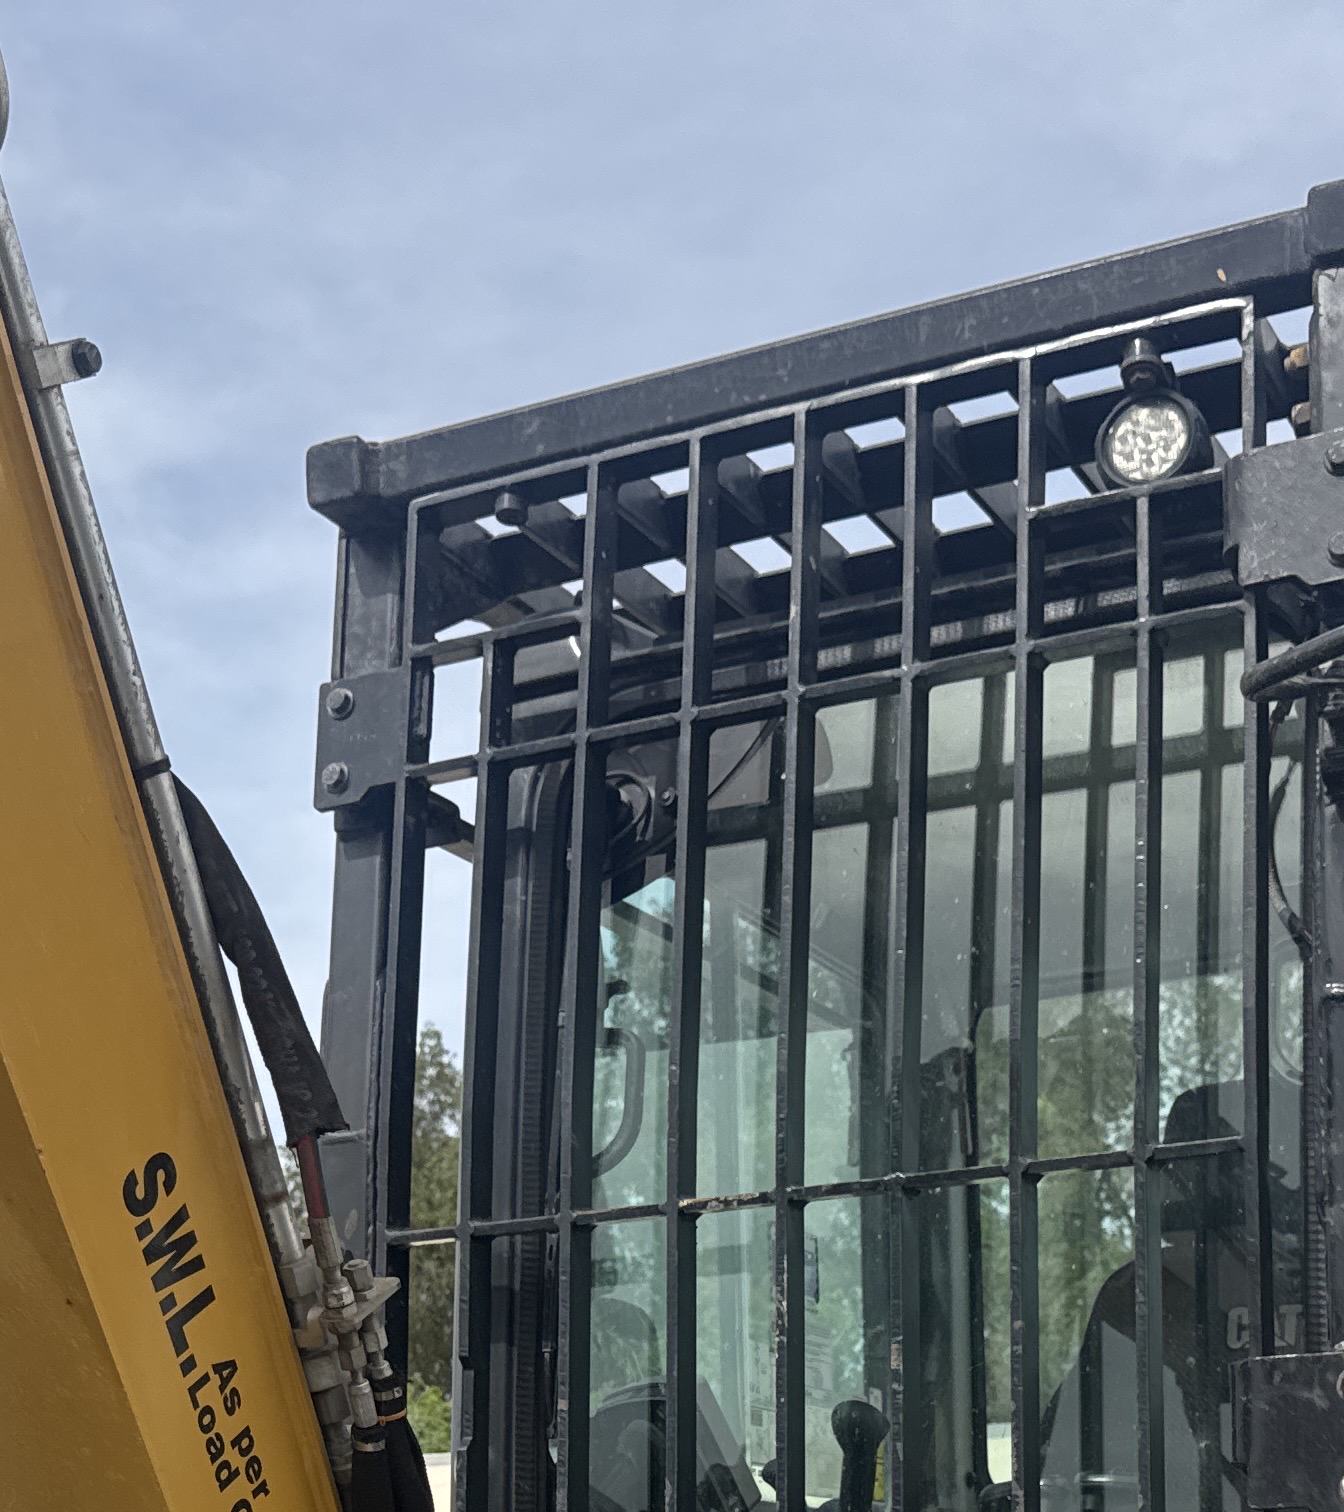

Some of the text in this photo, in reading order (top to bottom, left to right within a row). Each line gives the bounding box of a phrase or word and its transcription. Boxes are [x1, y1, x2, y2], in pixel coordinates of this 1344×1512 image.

[123, 1152, 216, 1379] S.W.L.
[187, 1371, 241, 1493] Load
[211, 1359, 271, 1499] As per
